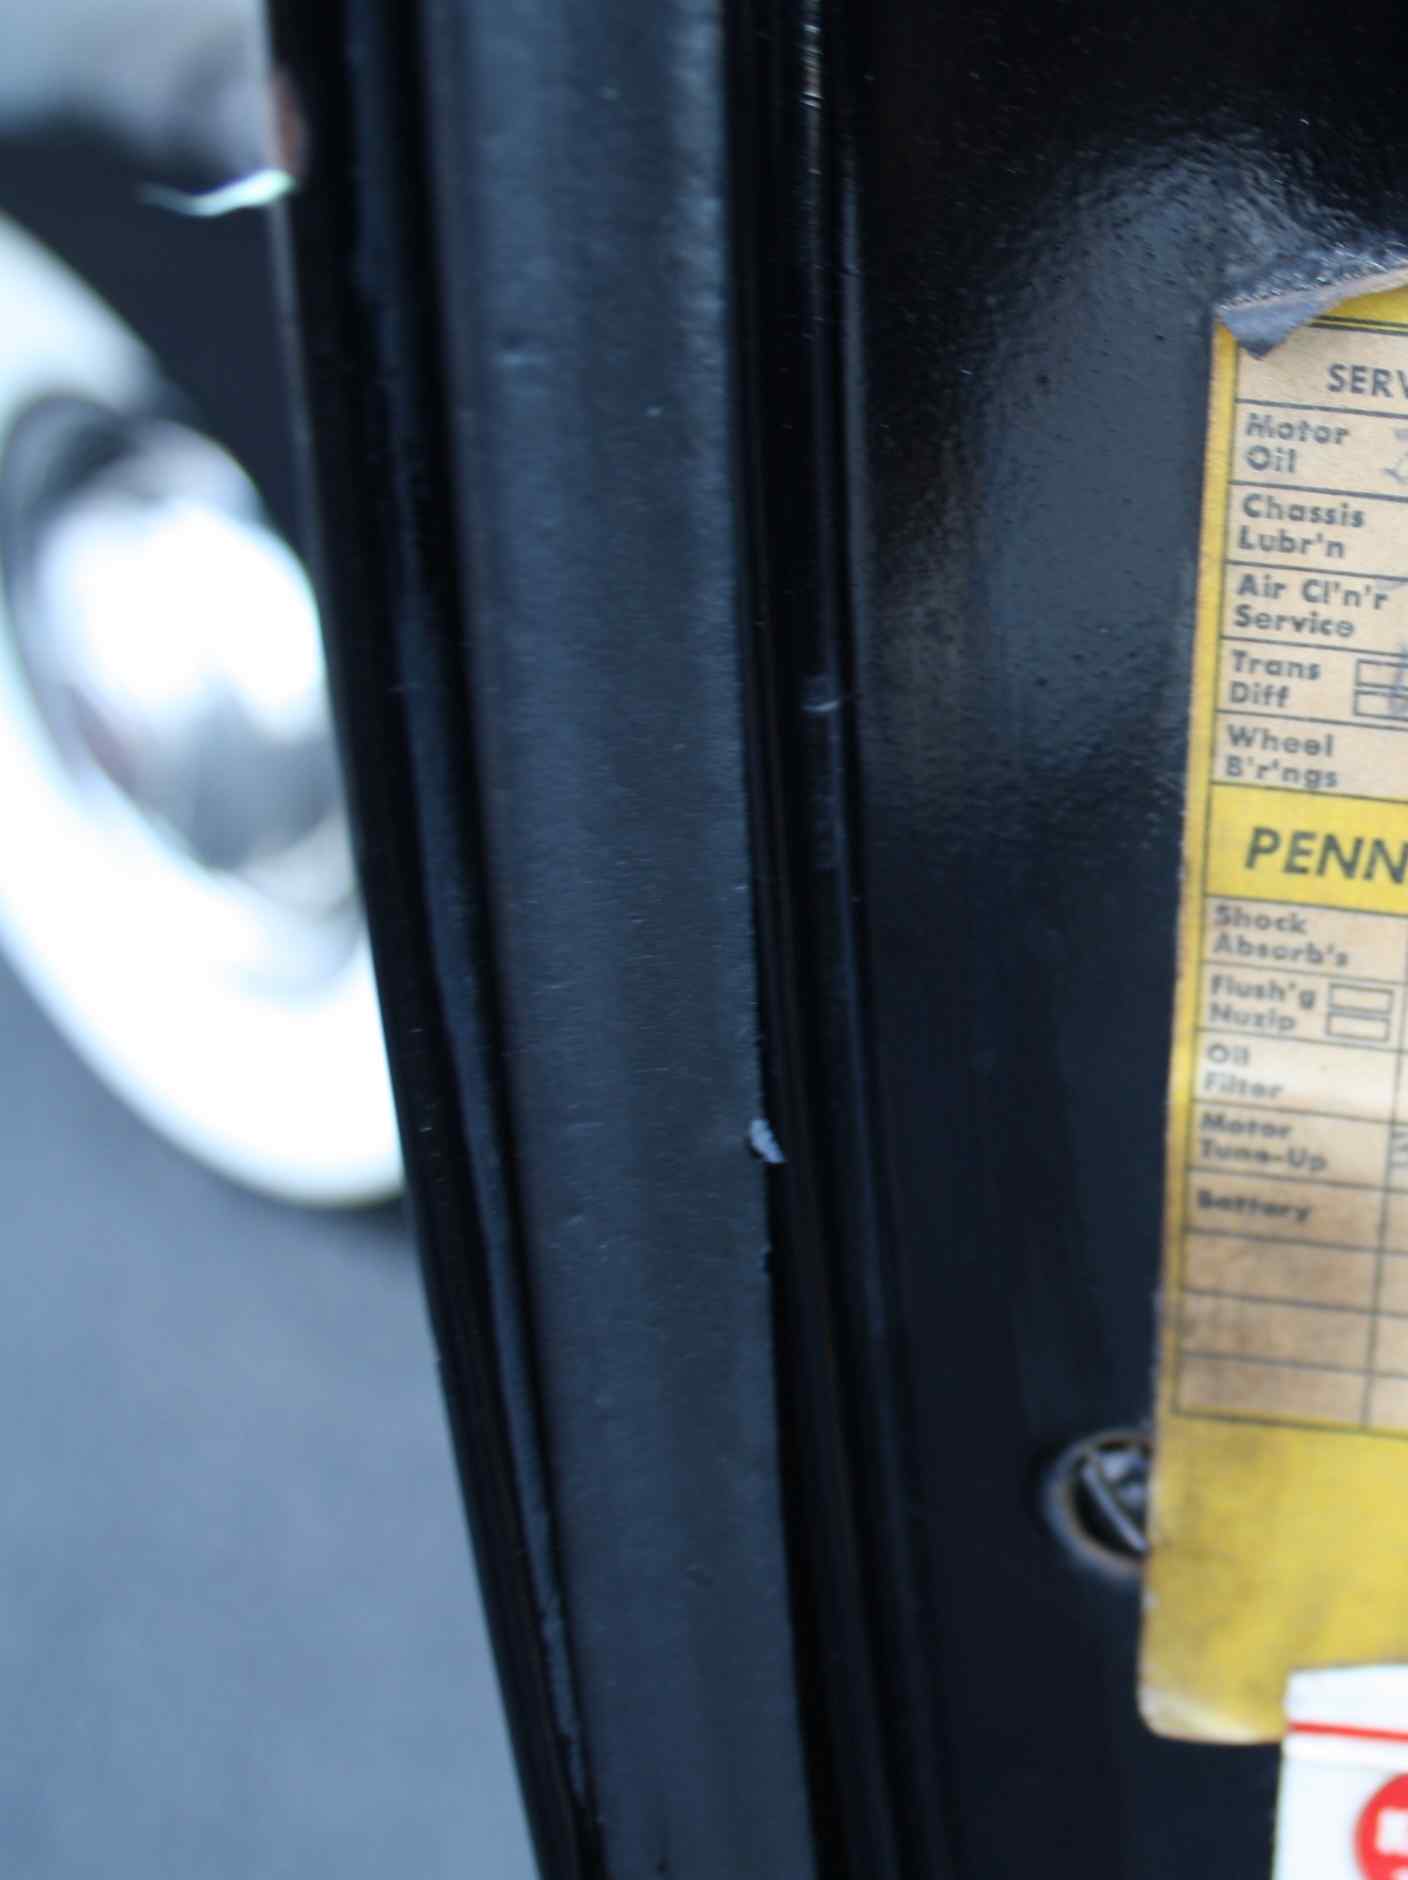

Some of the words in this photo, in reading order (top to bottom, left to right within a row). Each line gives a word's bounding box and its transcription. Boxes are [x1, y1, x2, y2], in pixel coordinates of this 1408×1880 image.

[1246, 413, 1349, 446] Motor
[1246, 445, 1296, 473] Oil
[1242, 493, 1365, 528] Chassis
[1239, 525, 1344, 559] Lubr'n
[1237, 575, 1286, 600] Air
[1301, 578, 1389, 610] Cl'n'r
[1233, 604, 1355, 639] Service
[1231, 650, 1321, 681] Trans
[1229, 681, 1290, 709] Diff
[1227, 724, 1335, 759] Wheel
[1225, 755, 1339, 790] B'r'ngs
[1214, 905, 1308, 935] Shock
[1212, 934, 1349, 968] Absorb's
[1210, 974, 1316, 1010] Flush'g
[1207, 1043, 1250, 1067] Oil
[1204, 1072, 1284, 1100] Filter
[1201, 1112, 1292, 1140] Motor
[1201, 1138, 1328, 1173] Tune-Up
[1196, 1190, 1311, 1224] Battery
